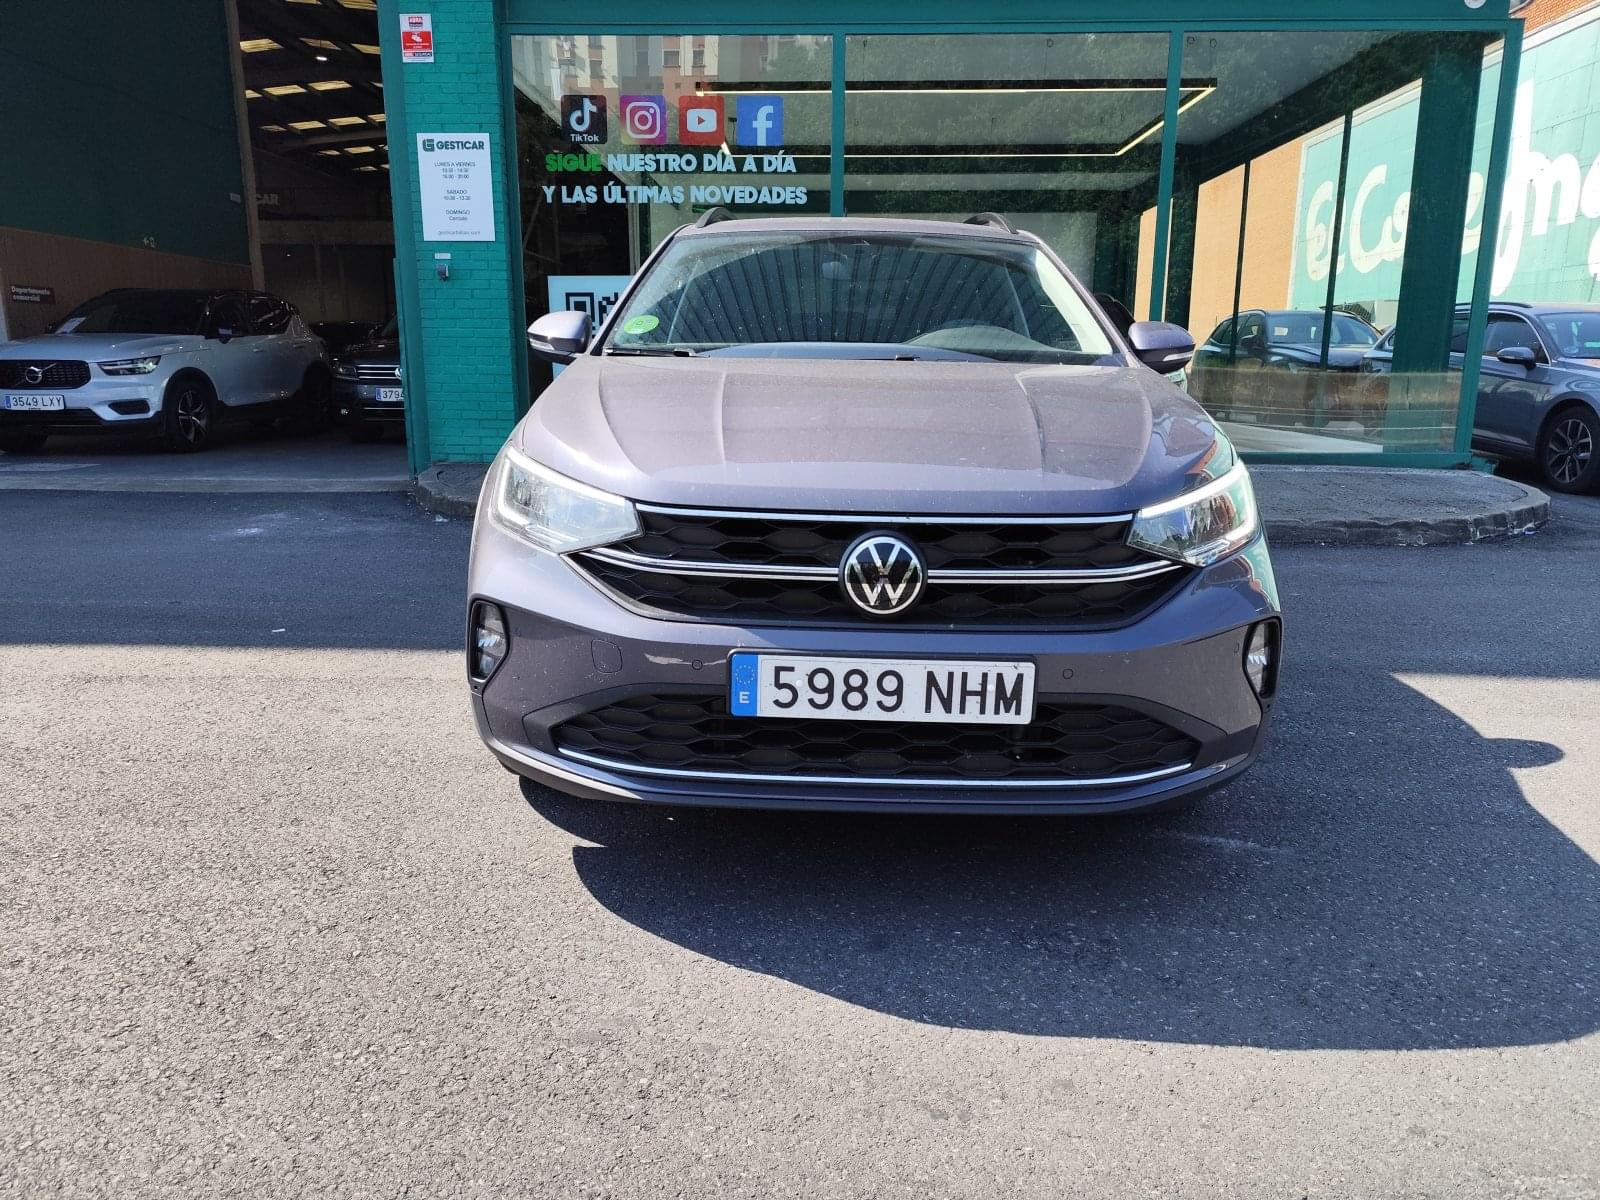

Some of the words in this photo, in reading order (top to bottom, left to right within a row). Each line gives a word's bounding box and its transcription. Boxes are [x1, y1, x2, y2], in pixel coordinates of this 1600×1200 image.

[436, 140, 485, 151] GESTICAR
[570, 133, 600, 143] TikTok
[544, 153, 602, 173] SIGUE
[607, 153, 698, 173] NUESTRO
[742, 153, 758, 173] A
[762, 150, 798, 173] DÍA
[541, 185, 556, 204] Y
[561, 185, 598, 204] LAS
[603, 181, 686, 204] ÚLTIMAS
[690, 185, 808, 205] NOVEDADES
[12, 396, 39, 407] 3549
[42, 396, 62, 407] LXY
[739, 691, 750, 704] E
[772, 665, 905, 714] 5989
[924, 670, 1025, 717] NHM
